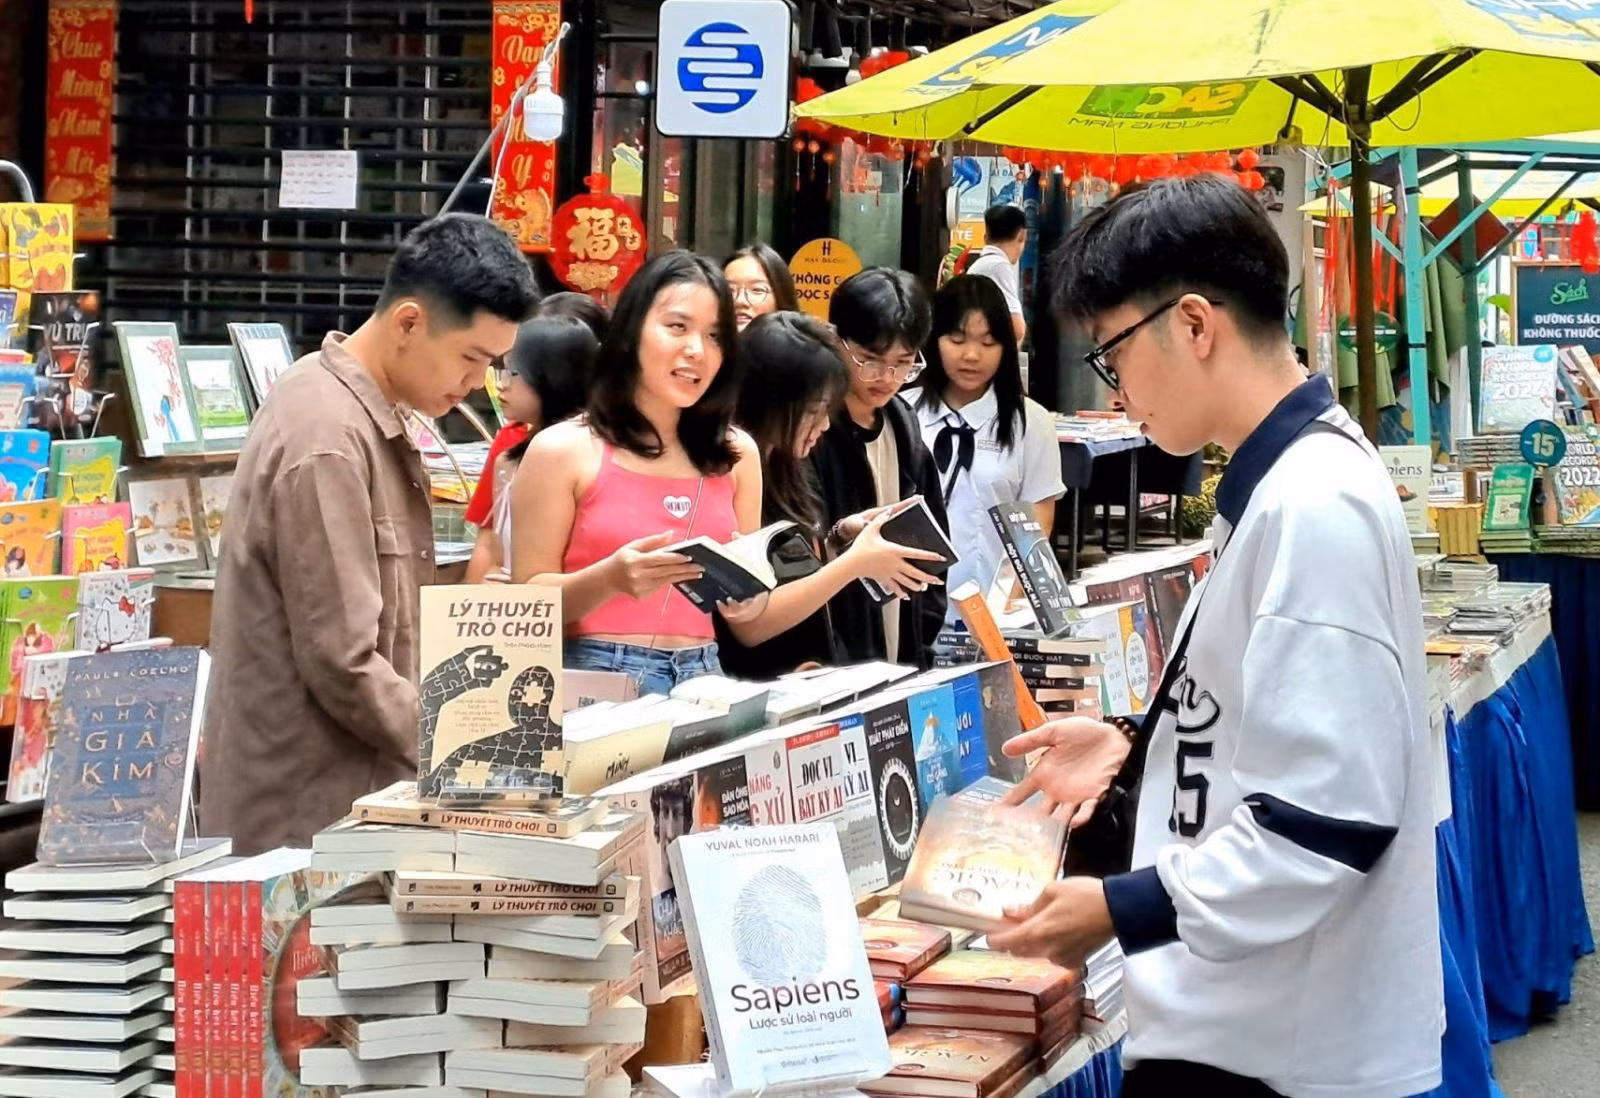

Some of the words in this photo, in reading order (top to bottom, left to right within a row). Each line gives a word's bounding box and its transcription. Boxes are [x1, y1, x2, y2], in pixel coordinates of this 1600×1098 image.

[792, 272, 831, 285] HÔNG
[1524, 327, 1562, 339] KHÔNG
[1567, 443, 1596, 455] ORLD
[1387, 463, 1423, 479] piens
[448, 599, 473, 618] LÝ
[477, 599, 555, 618] THUYẾT
[456, 618, 496, 637] TRÒ
[502, 621, 554, 637] CHƠI
[91, 701, 157, 722] NHÀ
[85, 725, 155, 752] GIẢ
[81, 759, 154, 785] KIM
[706, 839, 742, 851] YUVAL
[744, 836, 777, 848] NOAH
[779, 832, 820, 845] HARARI
[731, 976, 860, 1014] Sapiens
[749, 1016, 778, 1031] Lược
[781, 1012, 795, 1026] sử
[797, 1009, 817, 1024] loài
[820, 1007, 853, 1025] người
